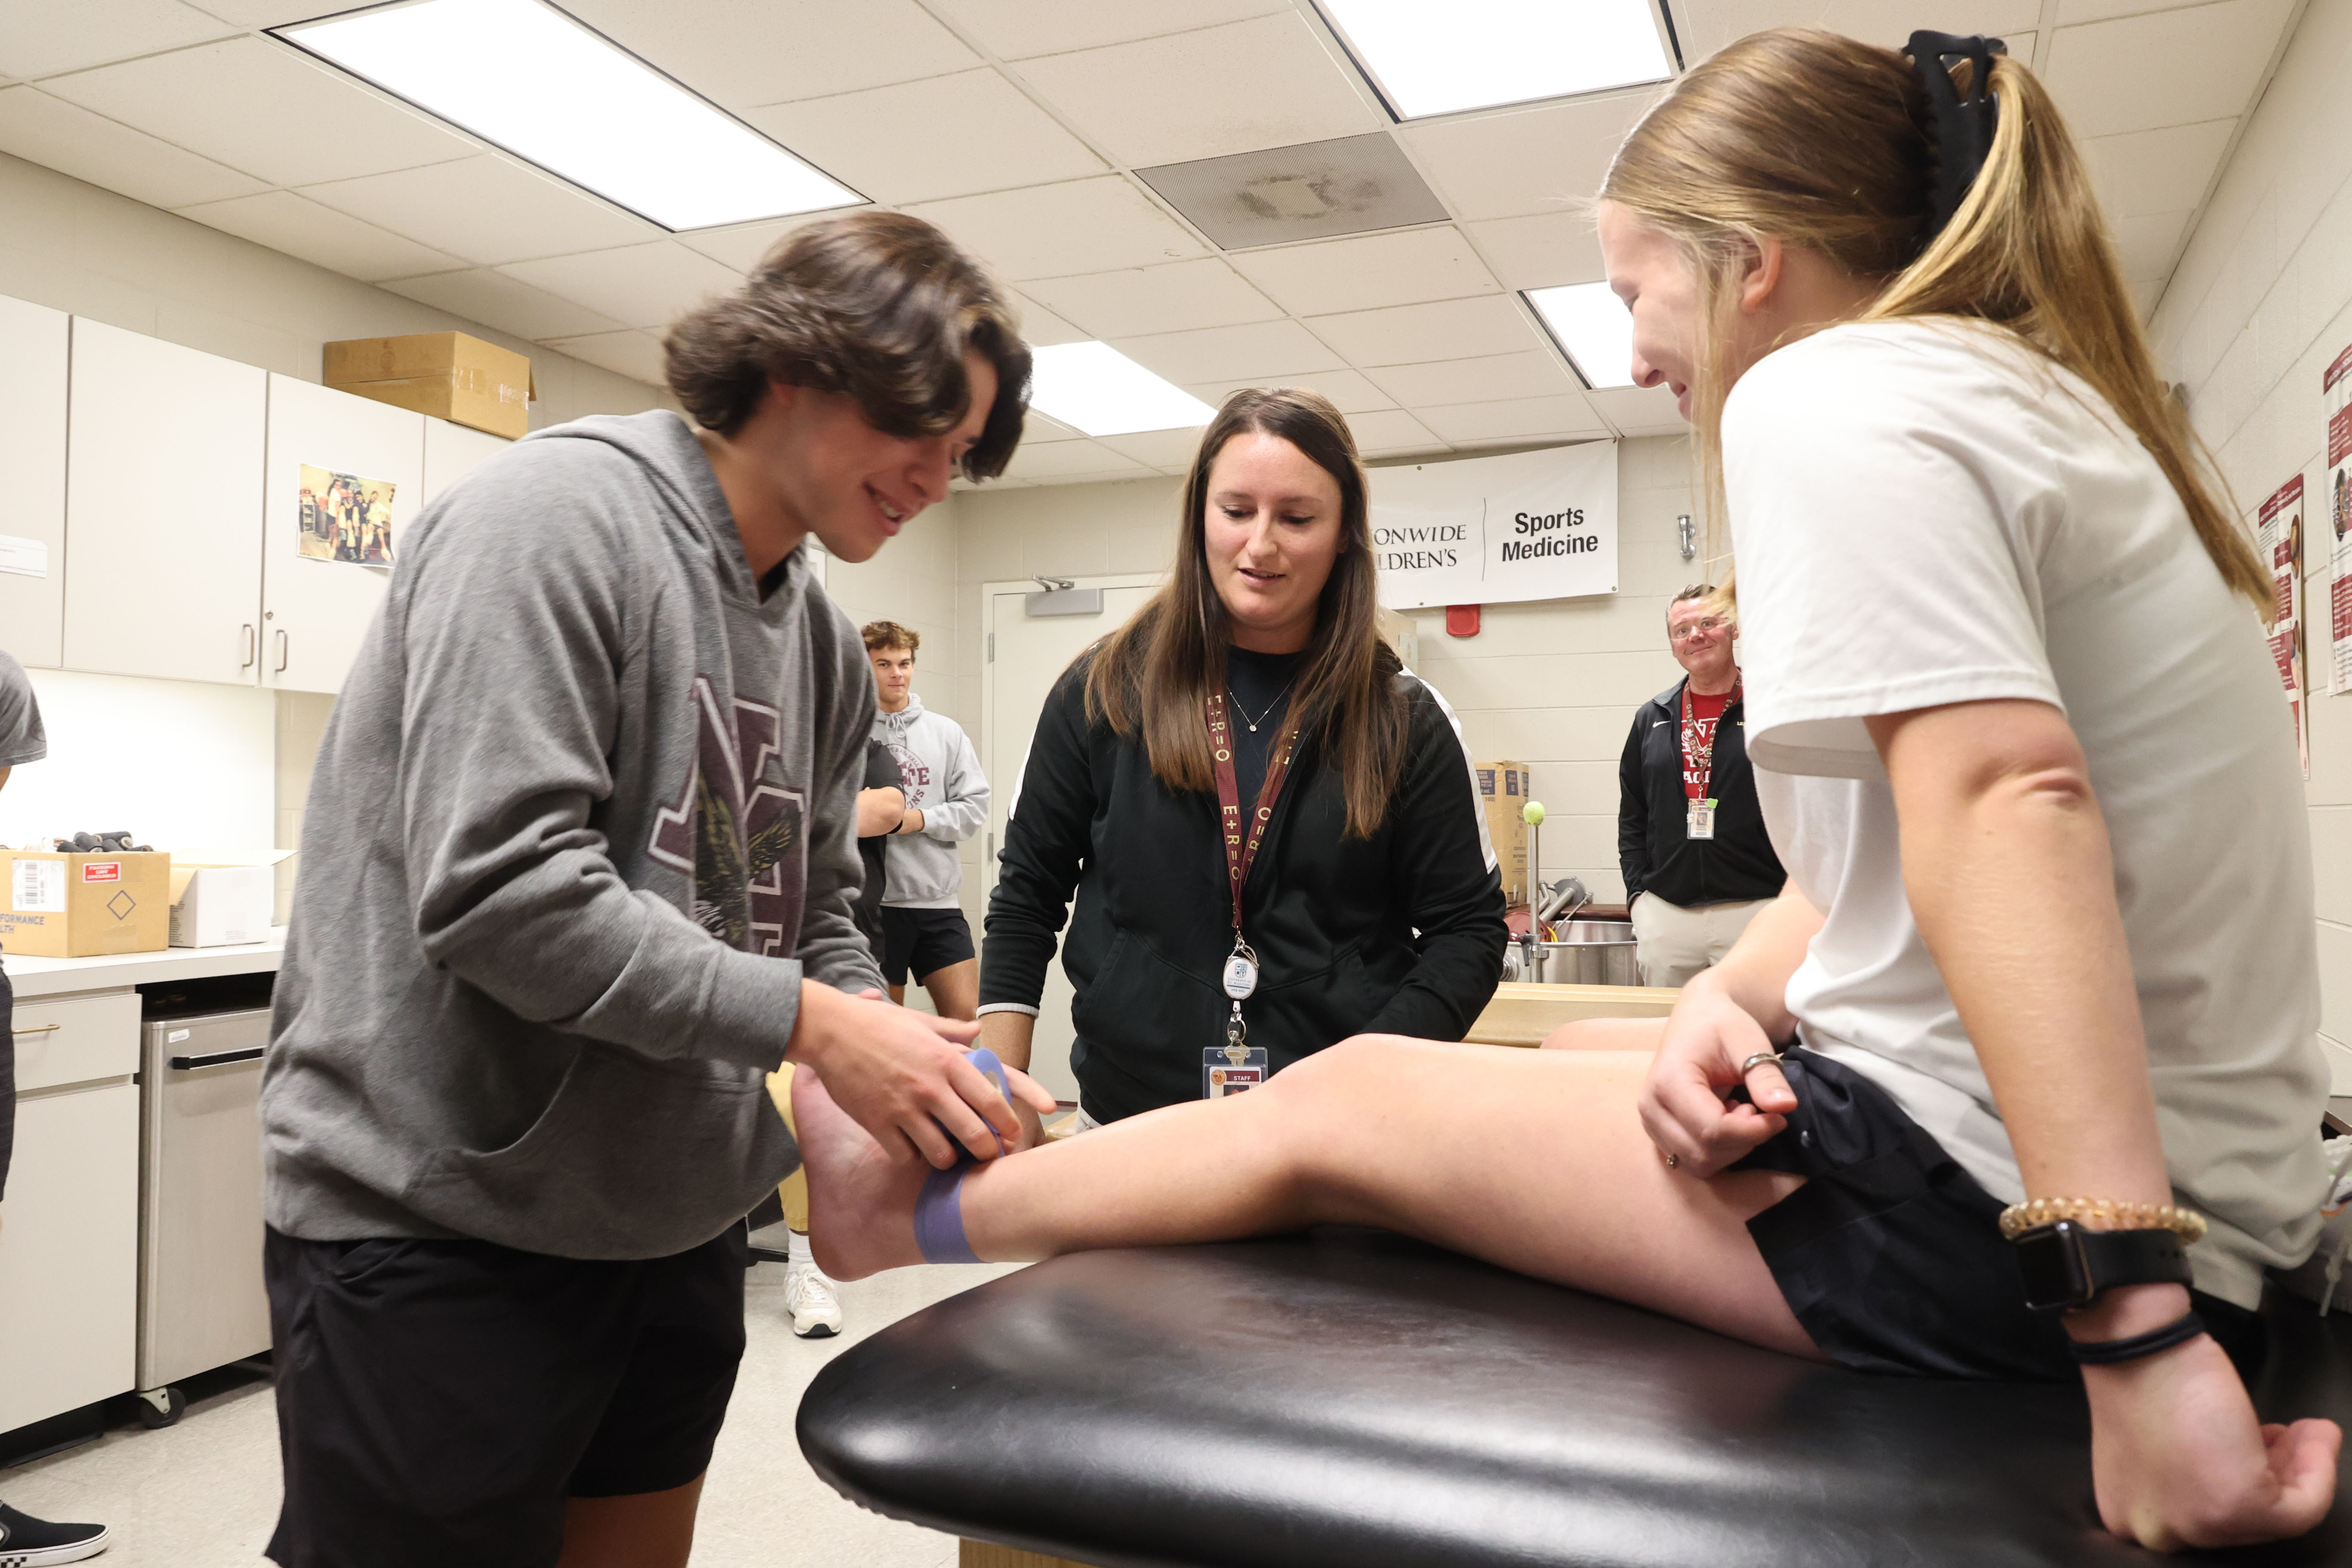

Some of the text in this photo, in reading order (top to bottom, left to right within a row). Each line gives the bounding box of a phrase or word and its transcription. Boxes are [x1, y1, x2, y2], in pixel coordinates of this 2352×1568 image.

[1374, 524, 1467, 545] ONWIDE
[1515, 508, 1584, 536] Sports
[1377, 548, 1457, 570] LDREN'S
[1502, 534, 1599, 562] Medicine
[1223, 805, 1240, 880] E+R=O
